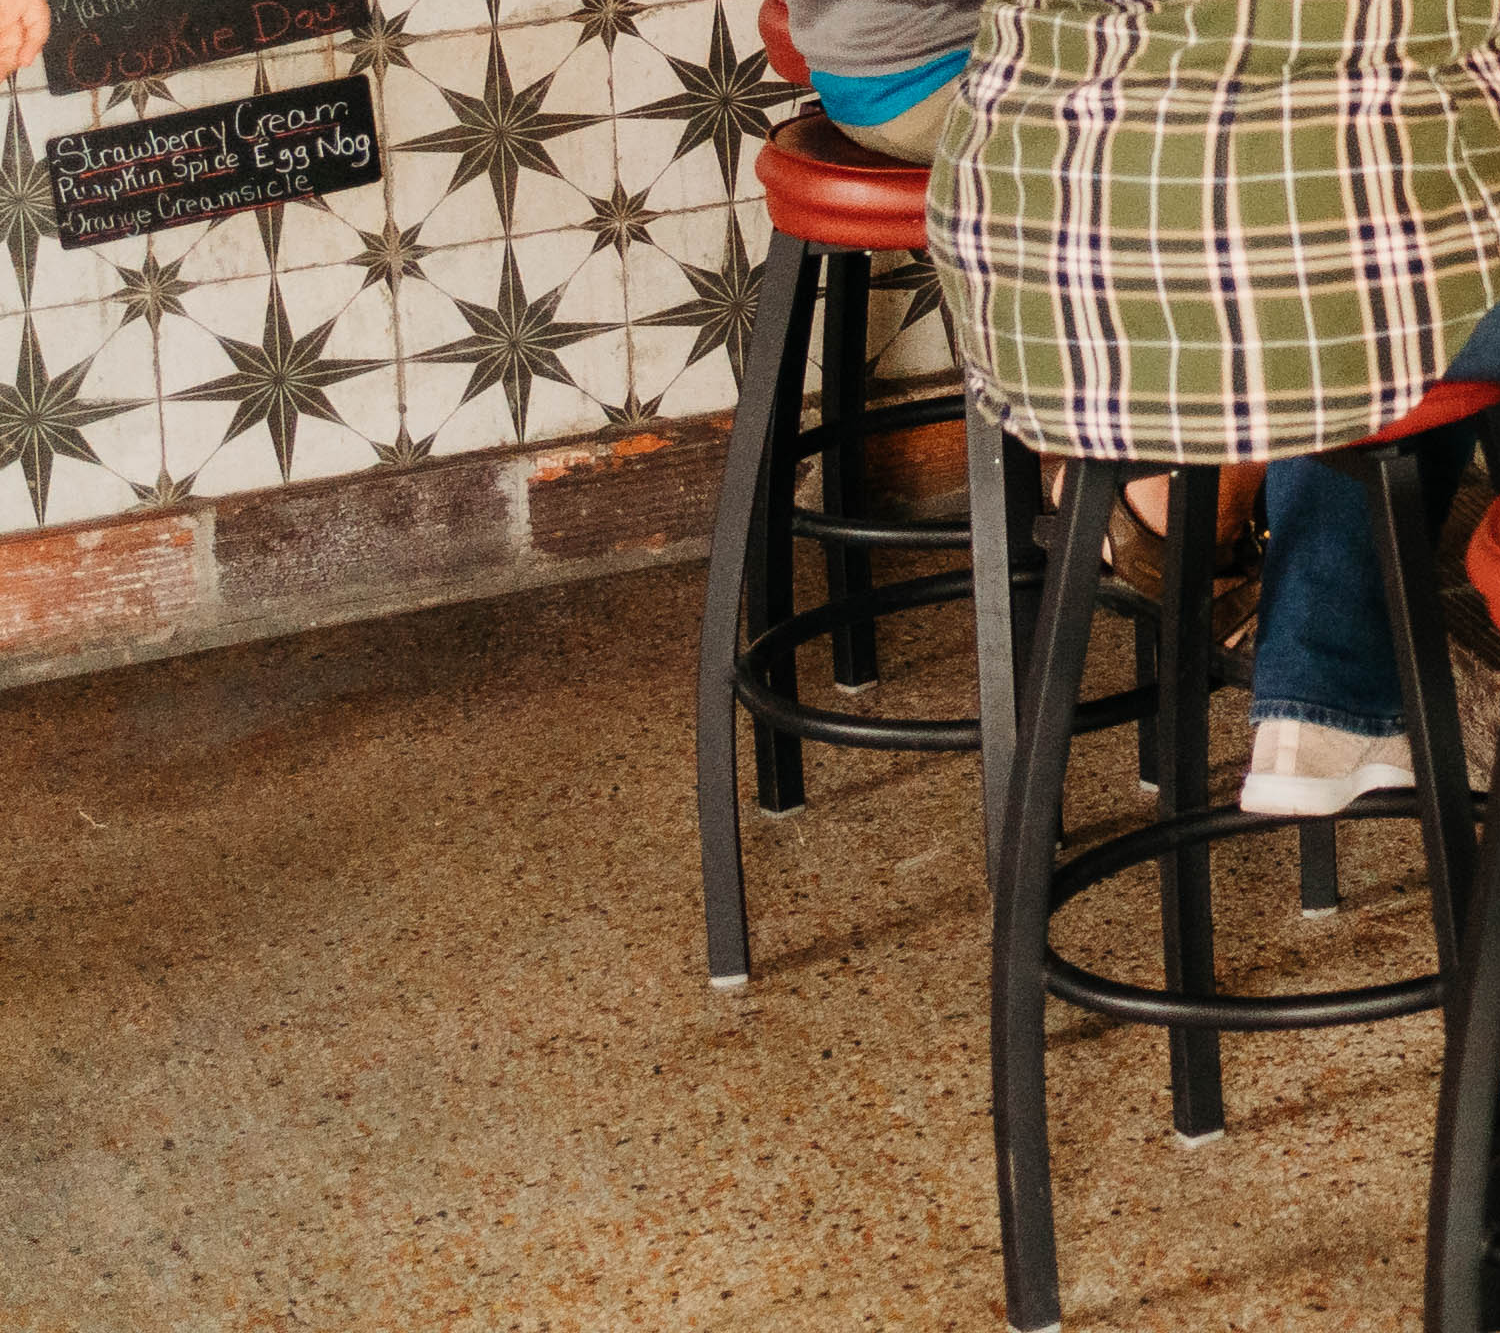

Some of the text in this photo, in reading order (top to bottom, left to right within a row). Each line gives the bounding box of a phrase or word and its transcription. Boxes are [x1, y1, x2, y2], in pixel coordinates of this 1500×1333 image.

[233, 99, 350, 141] Cream
[171, 149, 240, 183] Spice
[316, 124, 372, 169] Nog
